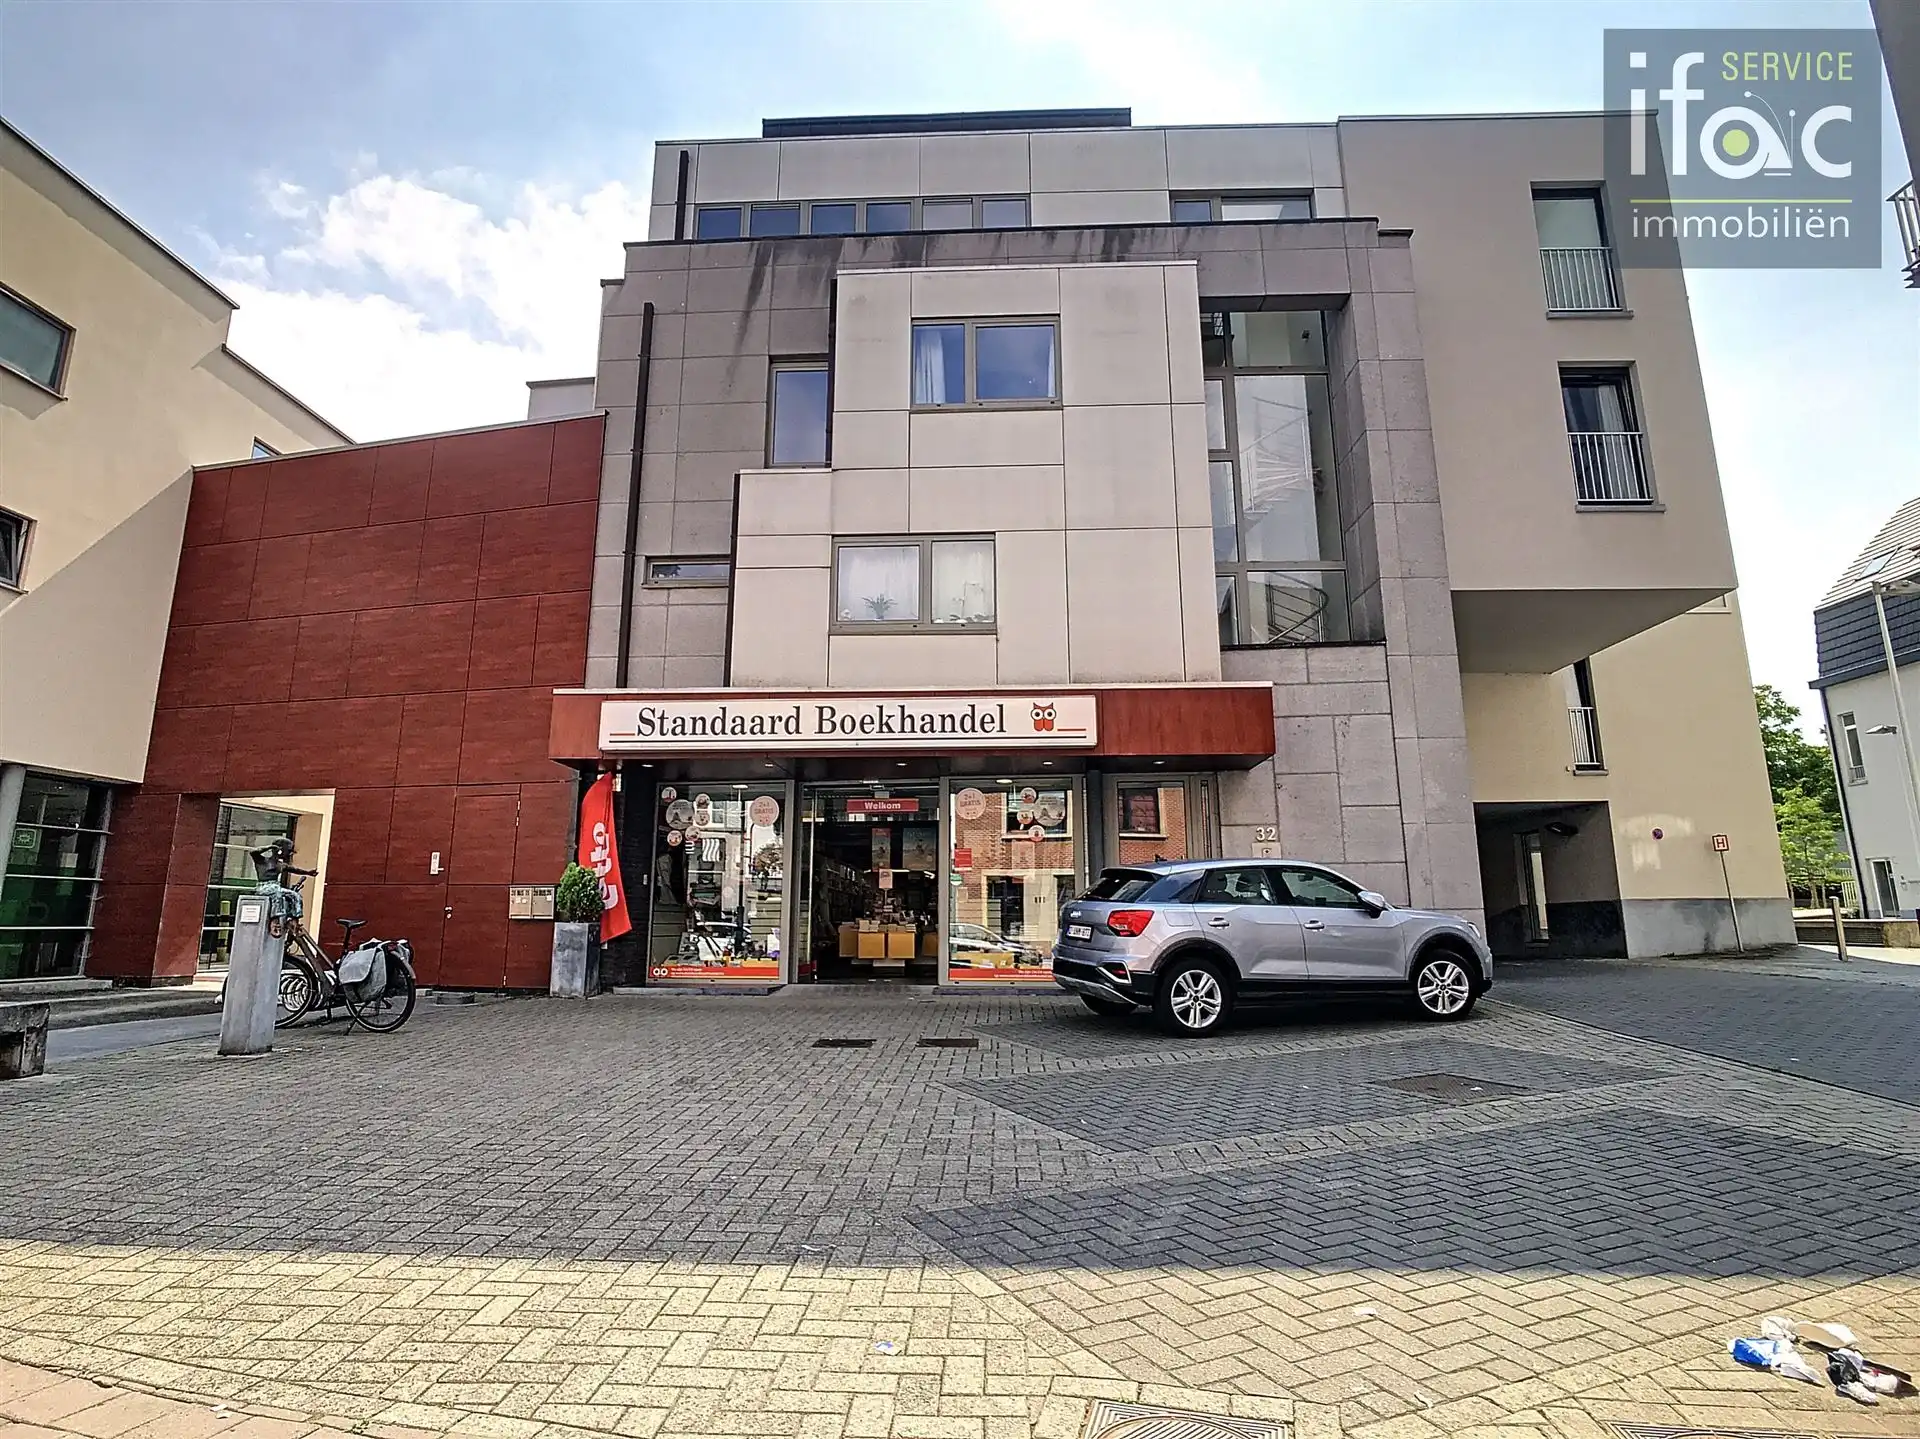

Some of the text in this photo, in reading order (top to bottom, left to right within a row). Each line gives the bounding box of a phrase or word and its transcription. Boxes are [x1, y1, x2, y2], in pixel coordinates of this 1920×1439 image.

[637, 703, 1007, 737] Standaard Boekhandel
[864, 802, 901, 810] Welkom
[1256, 826, 1276, 841] 32
[1716, 838, 1725, 848] H
